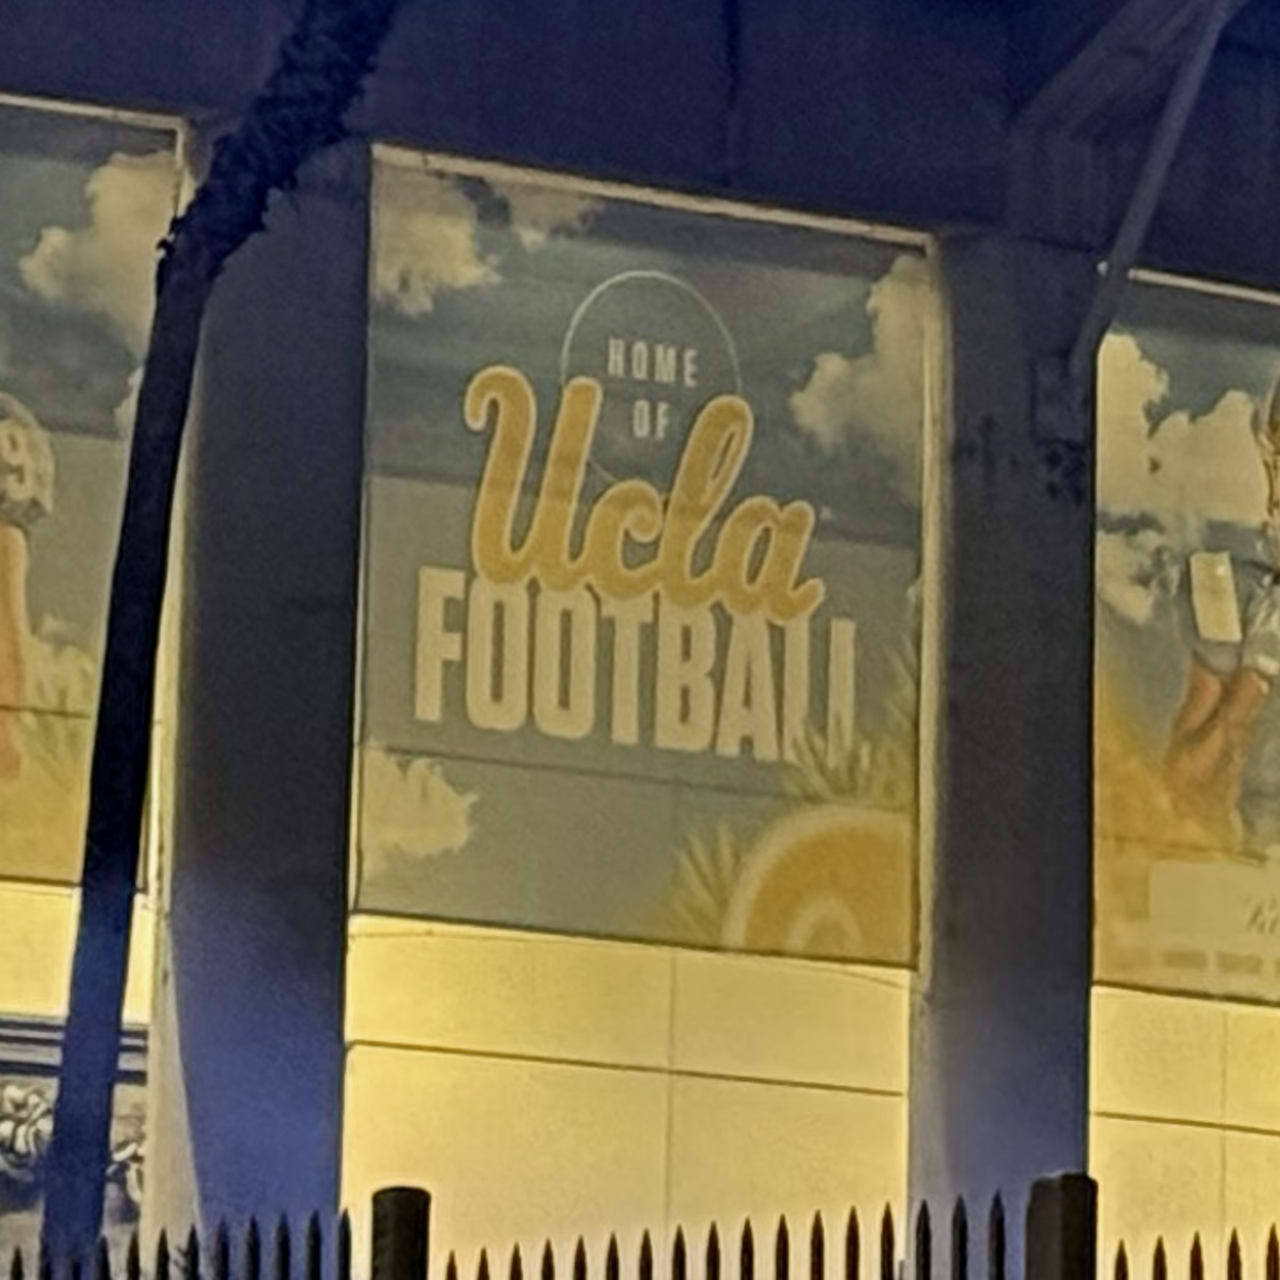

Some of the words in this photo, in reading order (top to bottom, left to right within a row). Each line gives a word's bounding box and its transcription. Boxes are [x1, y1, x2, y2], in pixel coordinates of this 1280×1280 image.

[607, 337, 697, 388] HOME
[633, 399, 669, 439] OF
[464, 366, 825, 624] Ucla
